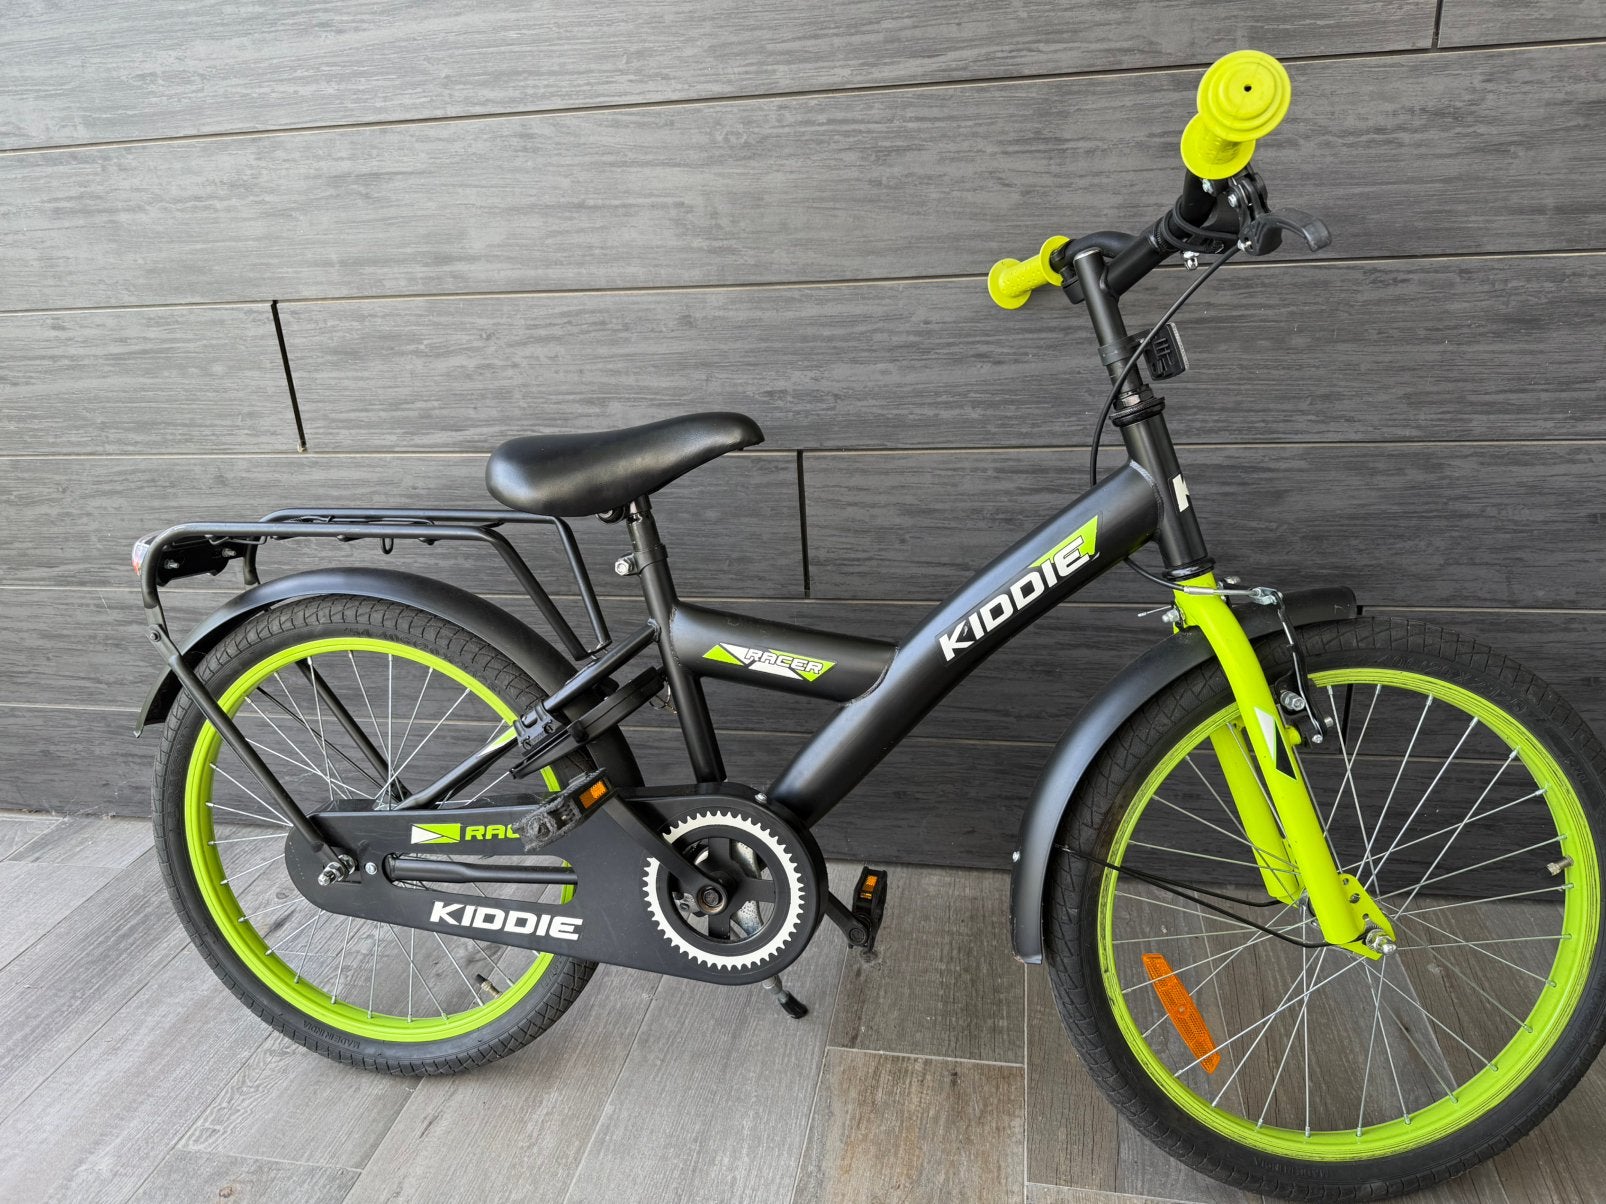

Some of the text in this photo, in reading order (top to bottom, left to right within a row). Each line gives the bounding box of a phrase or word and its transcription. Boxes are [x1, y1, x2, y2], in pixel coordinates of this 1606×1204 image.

[938, 535, 1090, 662] KIDDIE
[744, 648, 824, 675] RACER
[464, 824, 521, 841] RAC
[429, 901, 583, 941] KIDDIE
